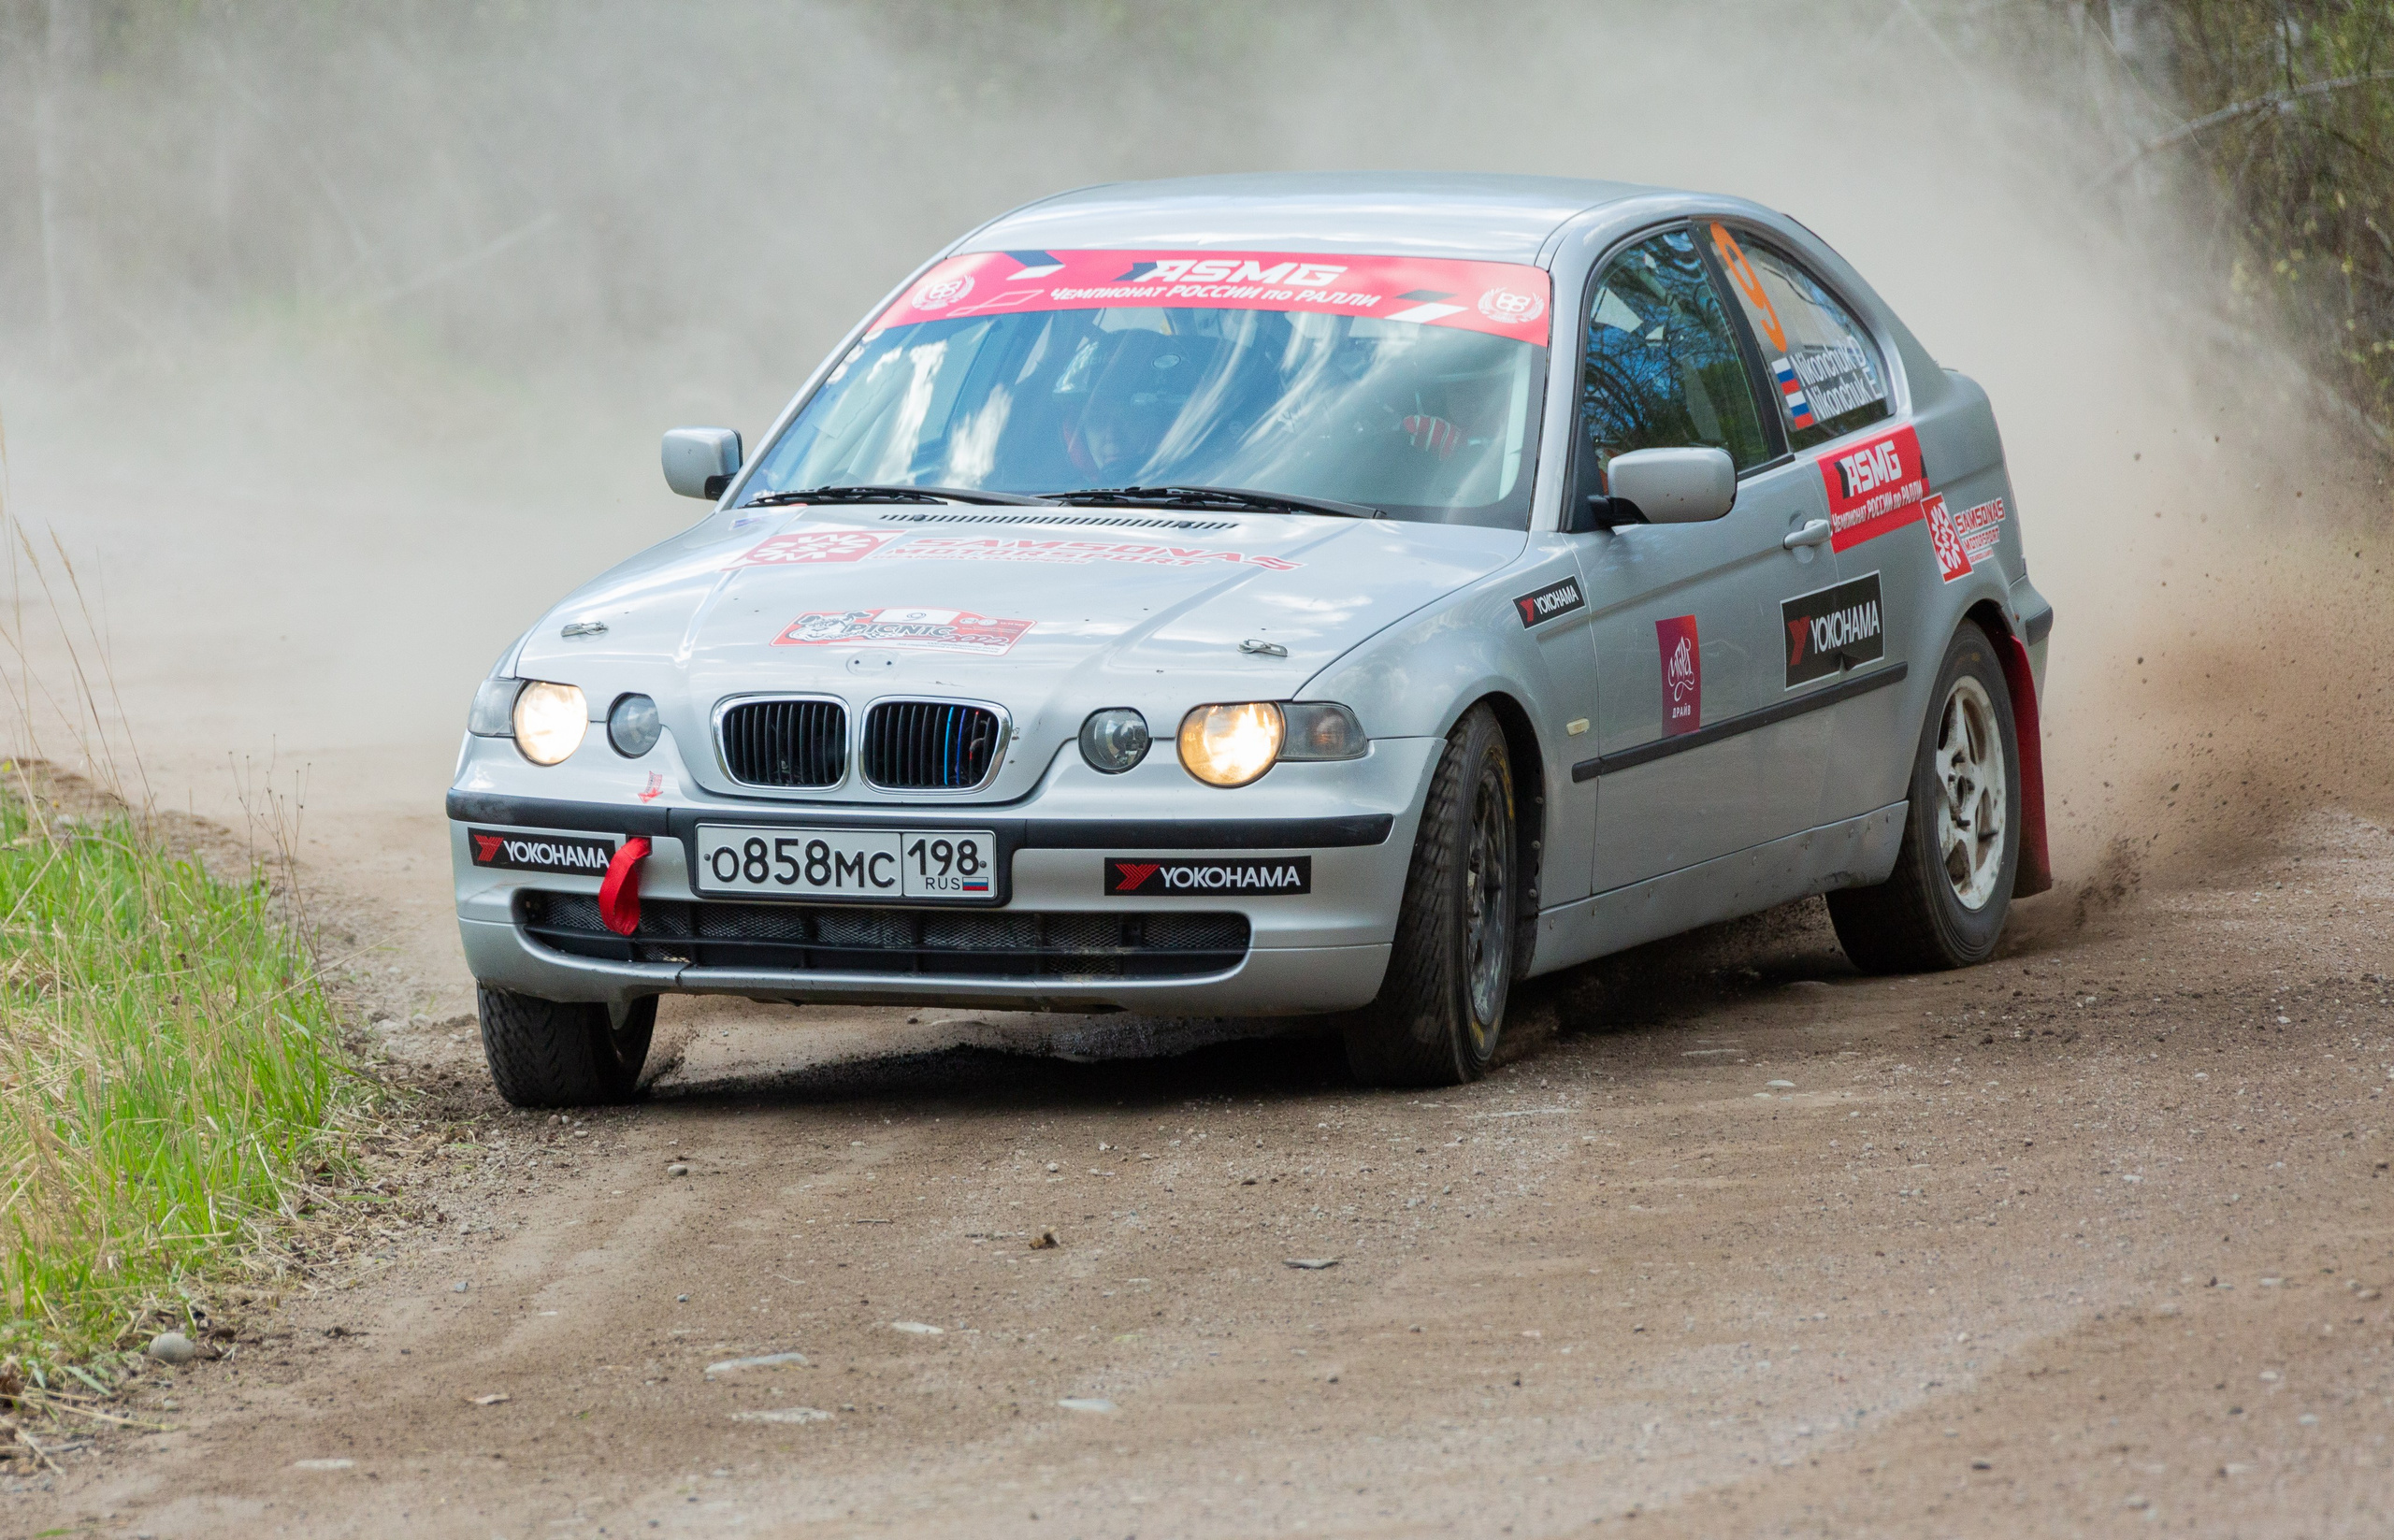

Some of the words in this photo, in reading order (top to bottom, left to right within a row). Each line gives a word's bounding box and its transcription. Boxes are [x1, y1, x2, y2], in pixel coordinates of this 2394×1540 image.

[1133, 260, 1348, 287] ASMG
[1710, 221, 1787, 353] 9
[1166, 284, 1262, 299] РОССИИ
[1294, 290, 1382, 308] РАЛЛИ
[1789, 338, 1857, 388] Nikonchuk
[1847, 335, 1867, 367] D
[1805, 371, 1873, 421] Nikonchuk
[1862, 366, 1884, 399] E
[1839, 439, 1902, 497] ASMG
[1866, 491, 1893, 520] РОССИИ
[1954, 498, 2005, 535] SAMSONAS
[887, 548, 1207, 566] MOTORSPORT
[904, 539, 1304, 571] SAMSONAS
[1534, 583, 1579, 615] YOKOHAMA
[843, 622, 958, 638] PICNIC
[1810, 599, 1881, 655] YOKOHAMA
[1671, 702, 1692, 719] ДРАЙВ
[503, 840, 610, 869] YOKOHAMA
[907, 838, 979, 876] 198
[925, 876, 960, 889] RUS
[1160, 865, 1302, 887] YOKOHAMA
